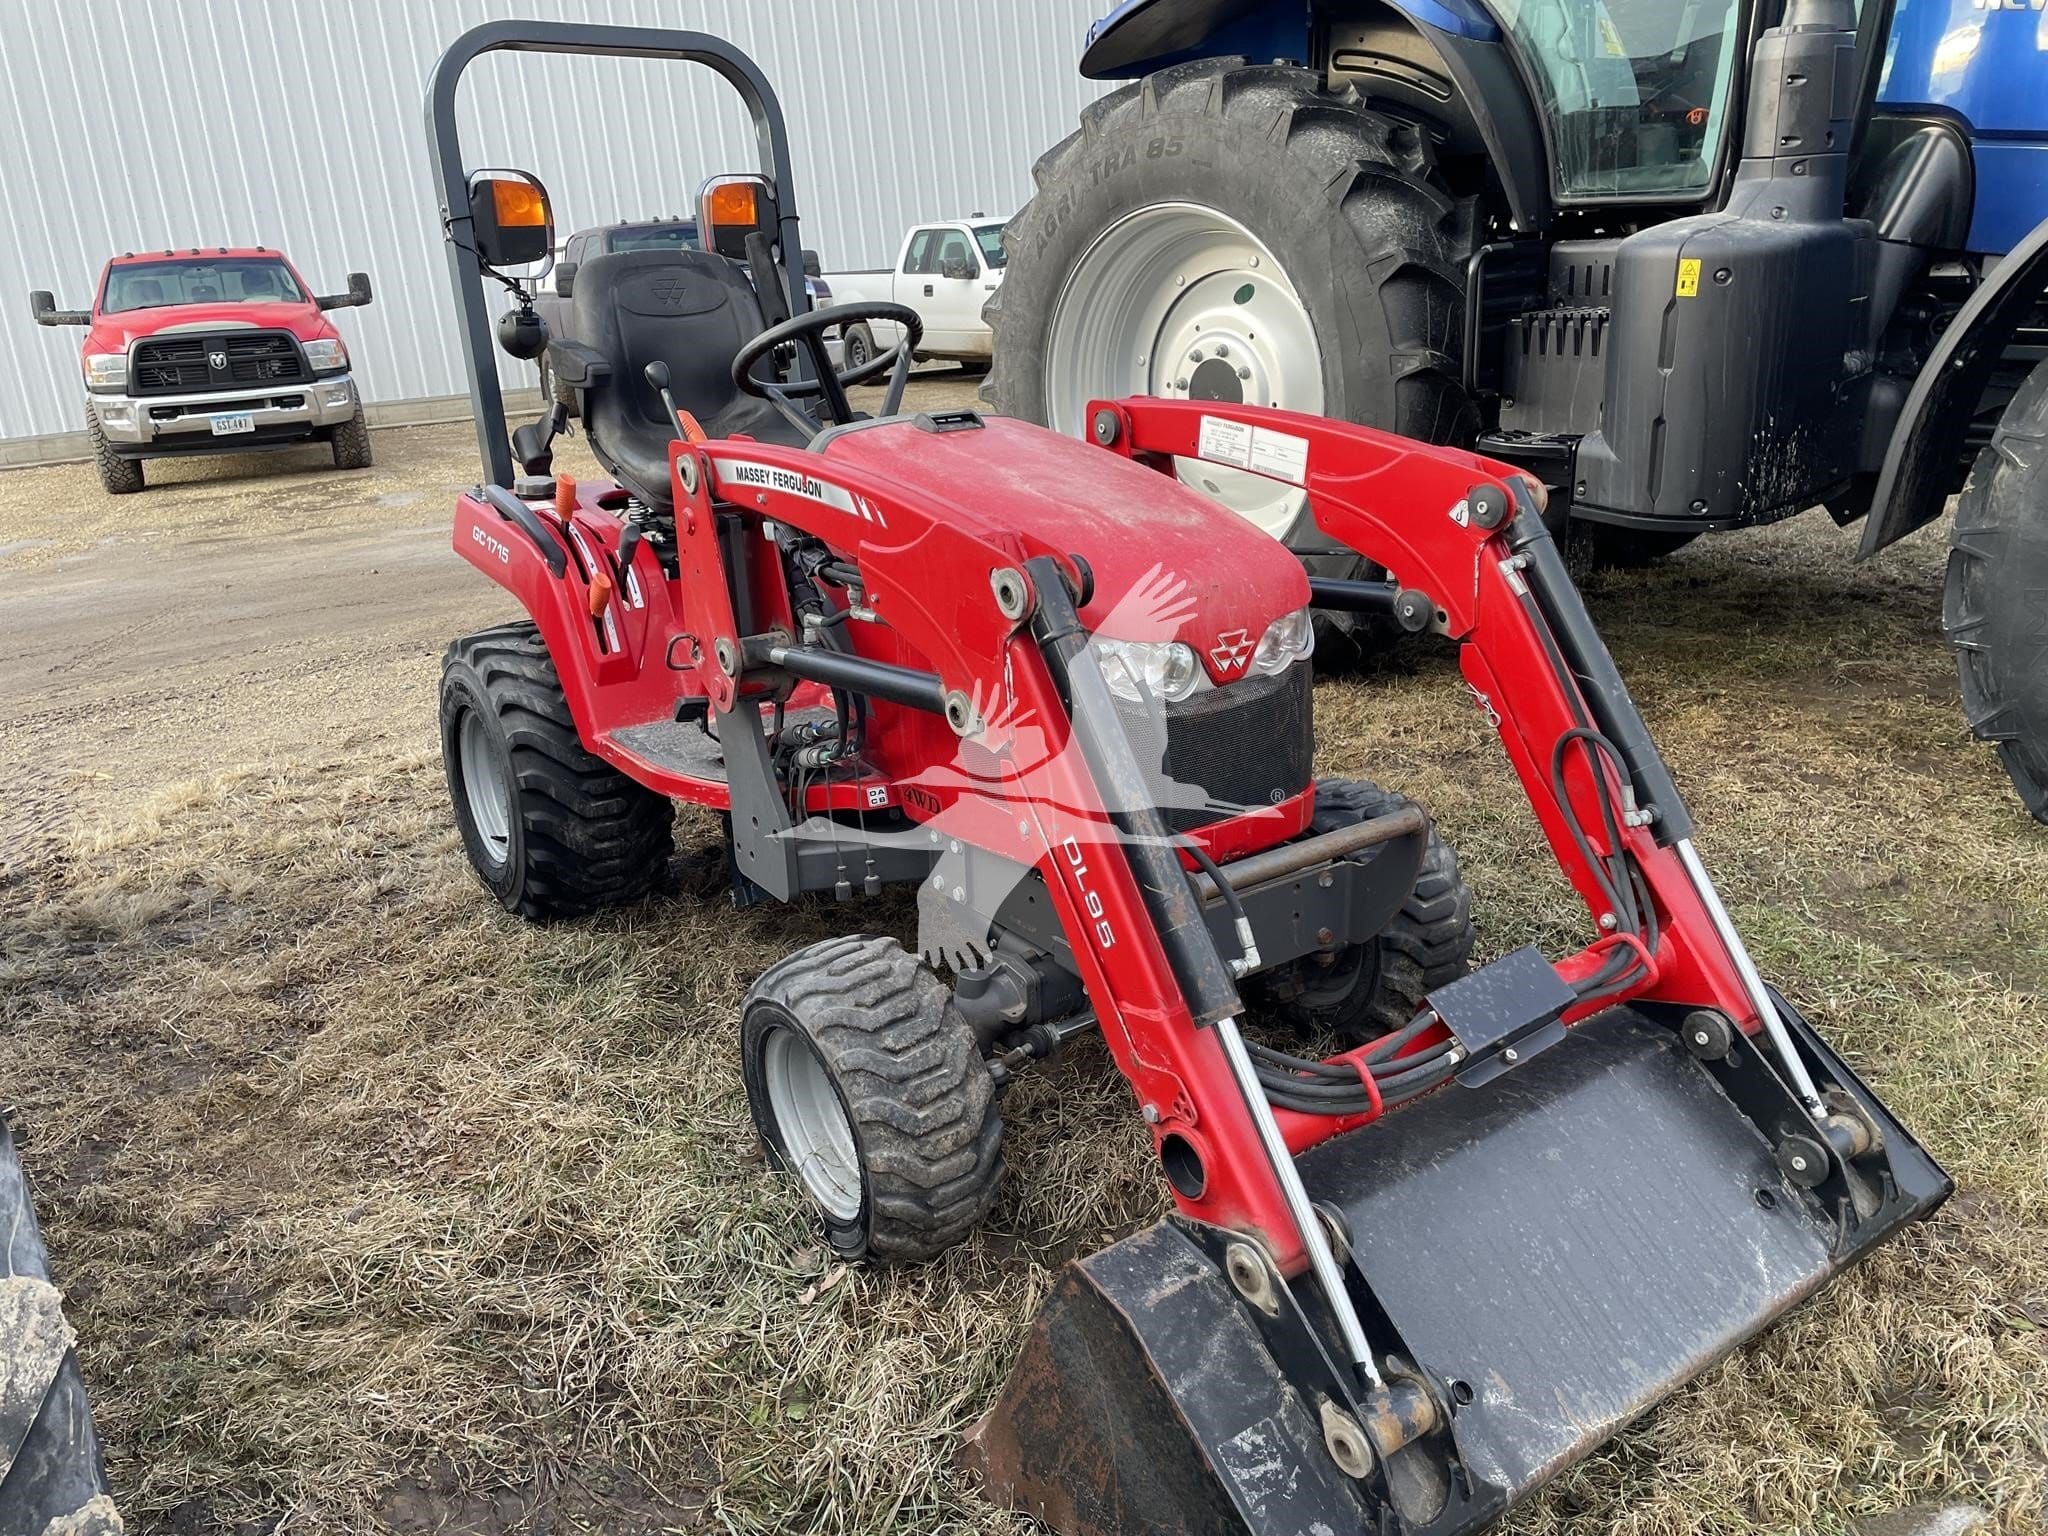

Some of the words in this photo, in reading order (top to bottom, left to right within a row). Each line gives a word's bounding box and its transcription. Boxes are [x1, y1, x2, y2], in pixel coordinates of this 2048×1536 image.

[1146, 135, 1186, 159] 85
[736, 466, 770, 485] MASSEY
[472, 525, 510, 565] GC1715
[904, 786, 942, 815] 4WD
[1062, 834, 1117, 949] DL95
